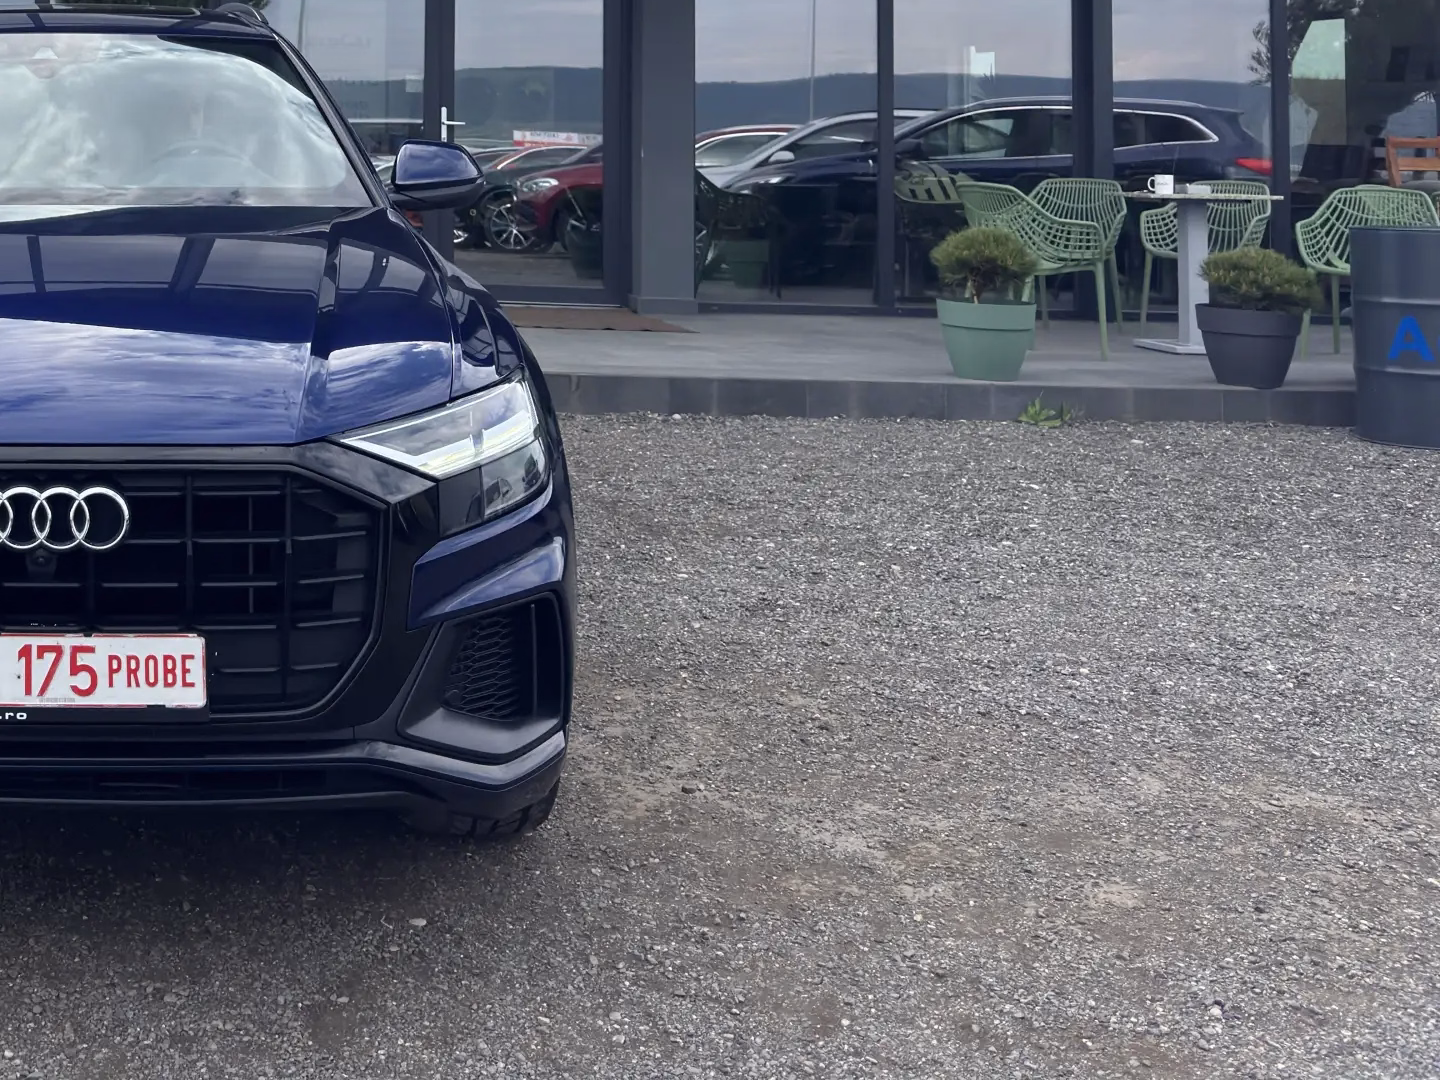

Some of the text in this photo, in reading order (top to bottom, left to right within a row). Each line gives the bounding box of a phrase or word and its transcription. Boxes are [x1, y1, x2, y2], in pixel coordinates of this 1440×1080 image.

[1387, 314, 1440, 362] A
[17, 643, 98, 698] 175
[107, 654, 196, 688] PROBE
